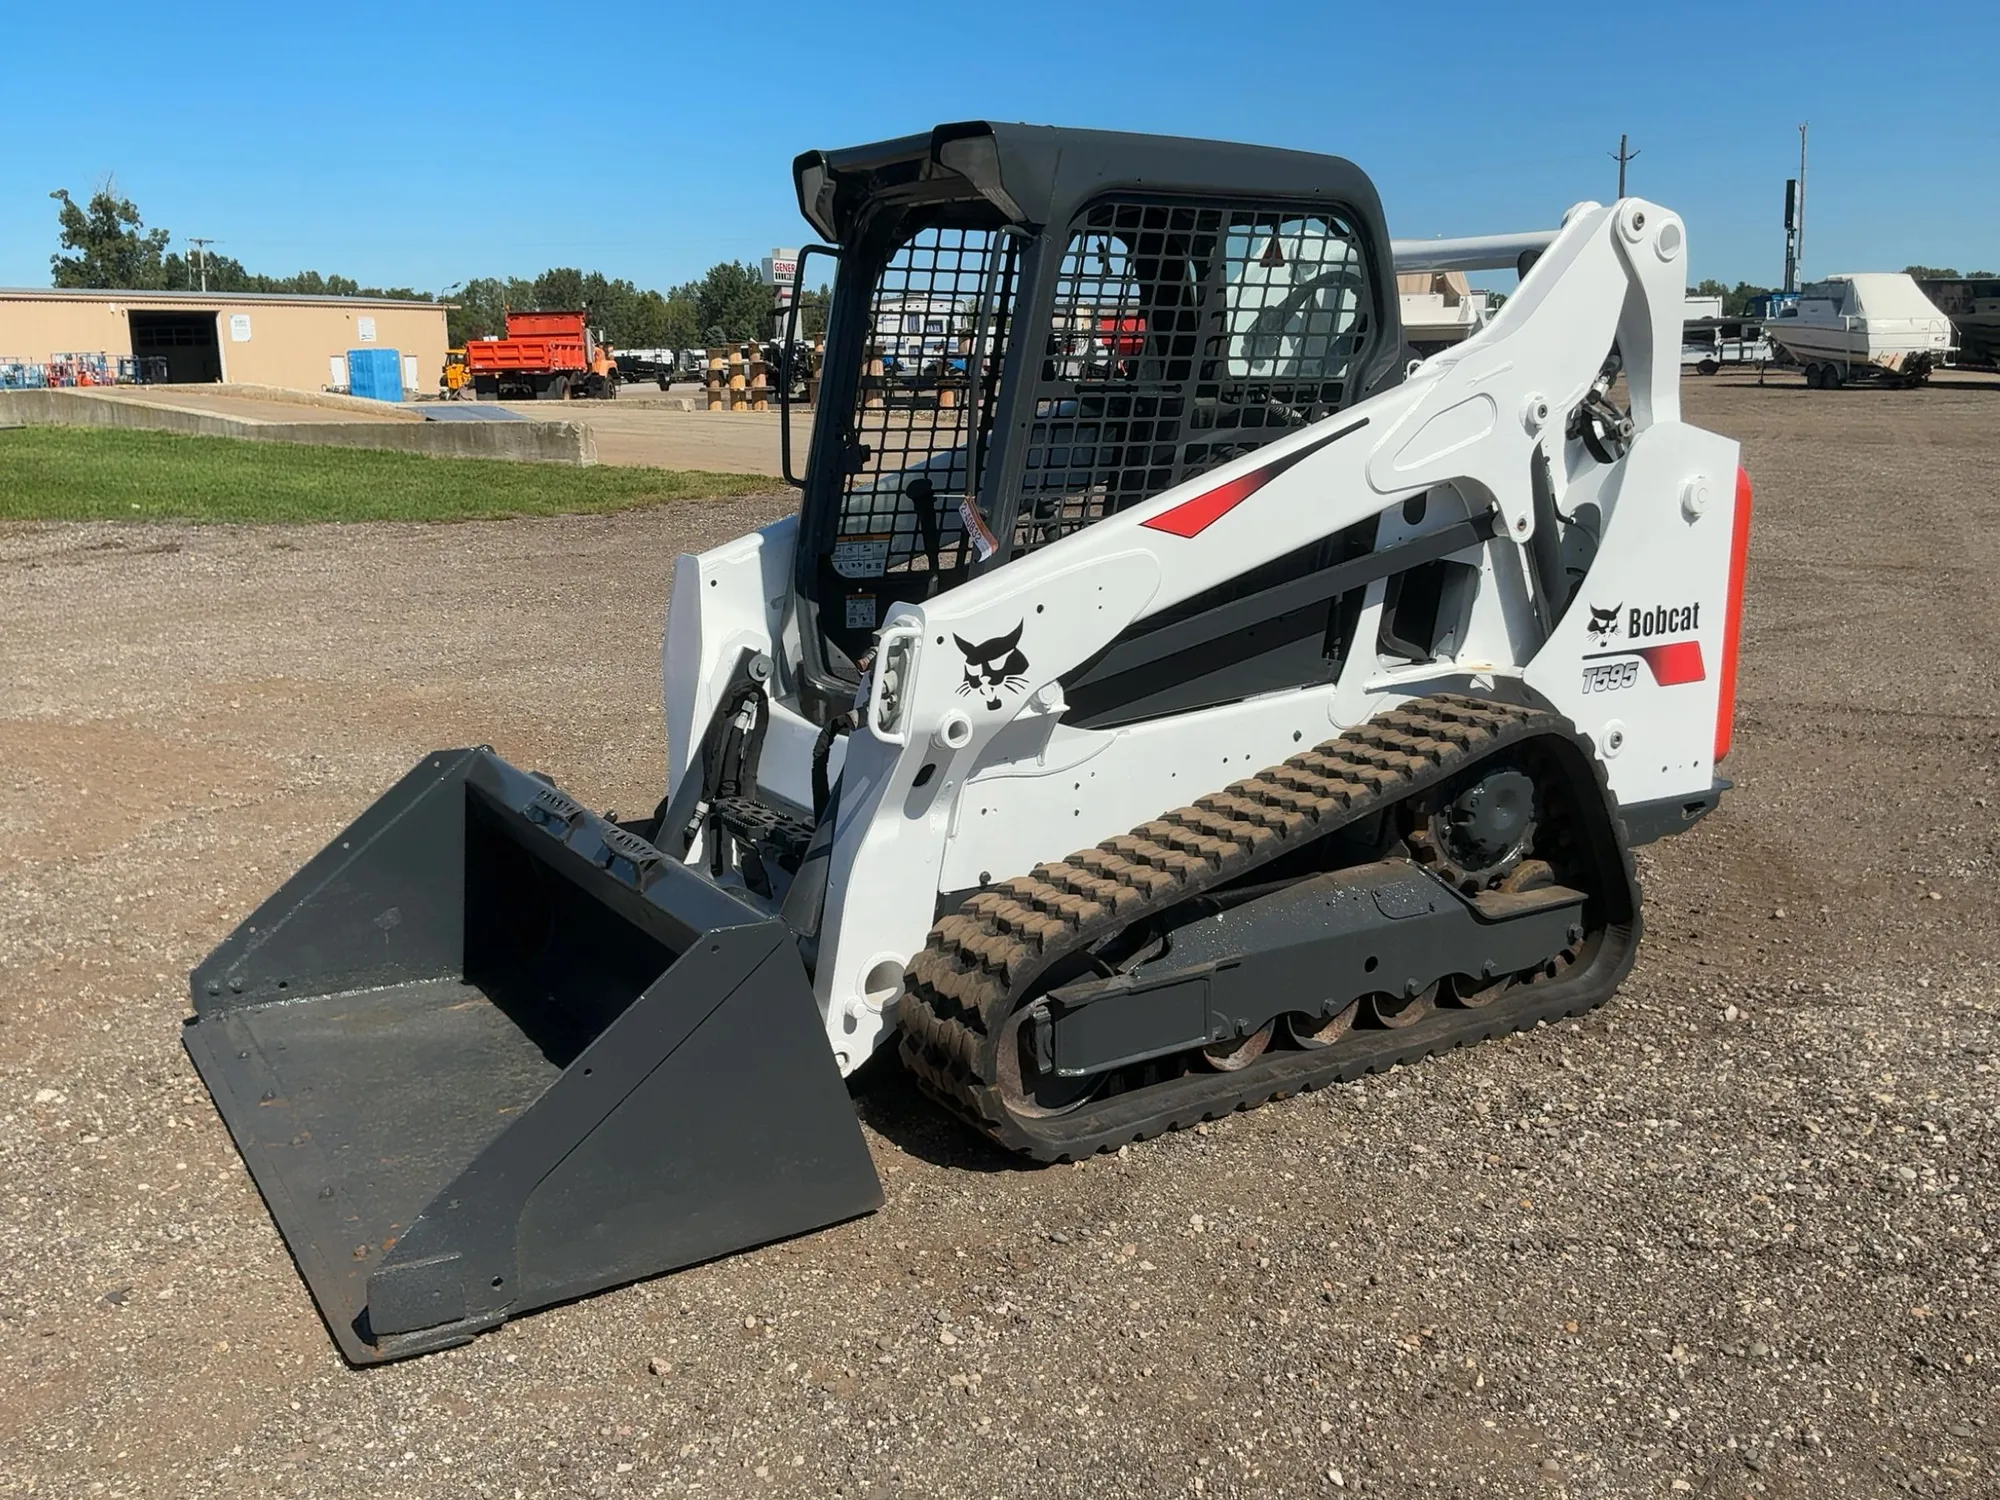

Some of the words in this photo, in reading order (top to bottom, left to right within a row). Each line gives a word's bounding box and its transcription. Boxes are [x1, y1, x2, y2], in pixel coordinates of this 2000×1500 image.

[775, 262, 796, 272] GENER
[960, 503, 982, 543] 2-40832
[1628, 602, 1700, 638] Bobcat
[1581, 661, 1639, 694] T595
